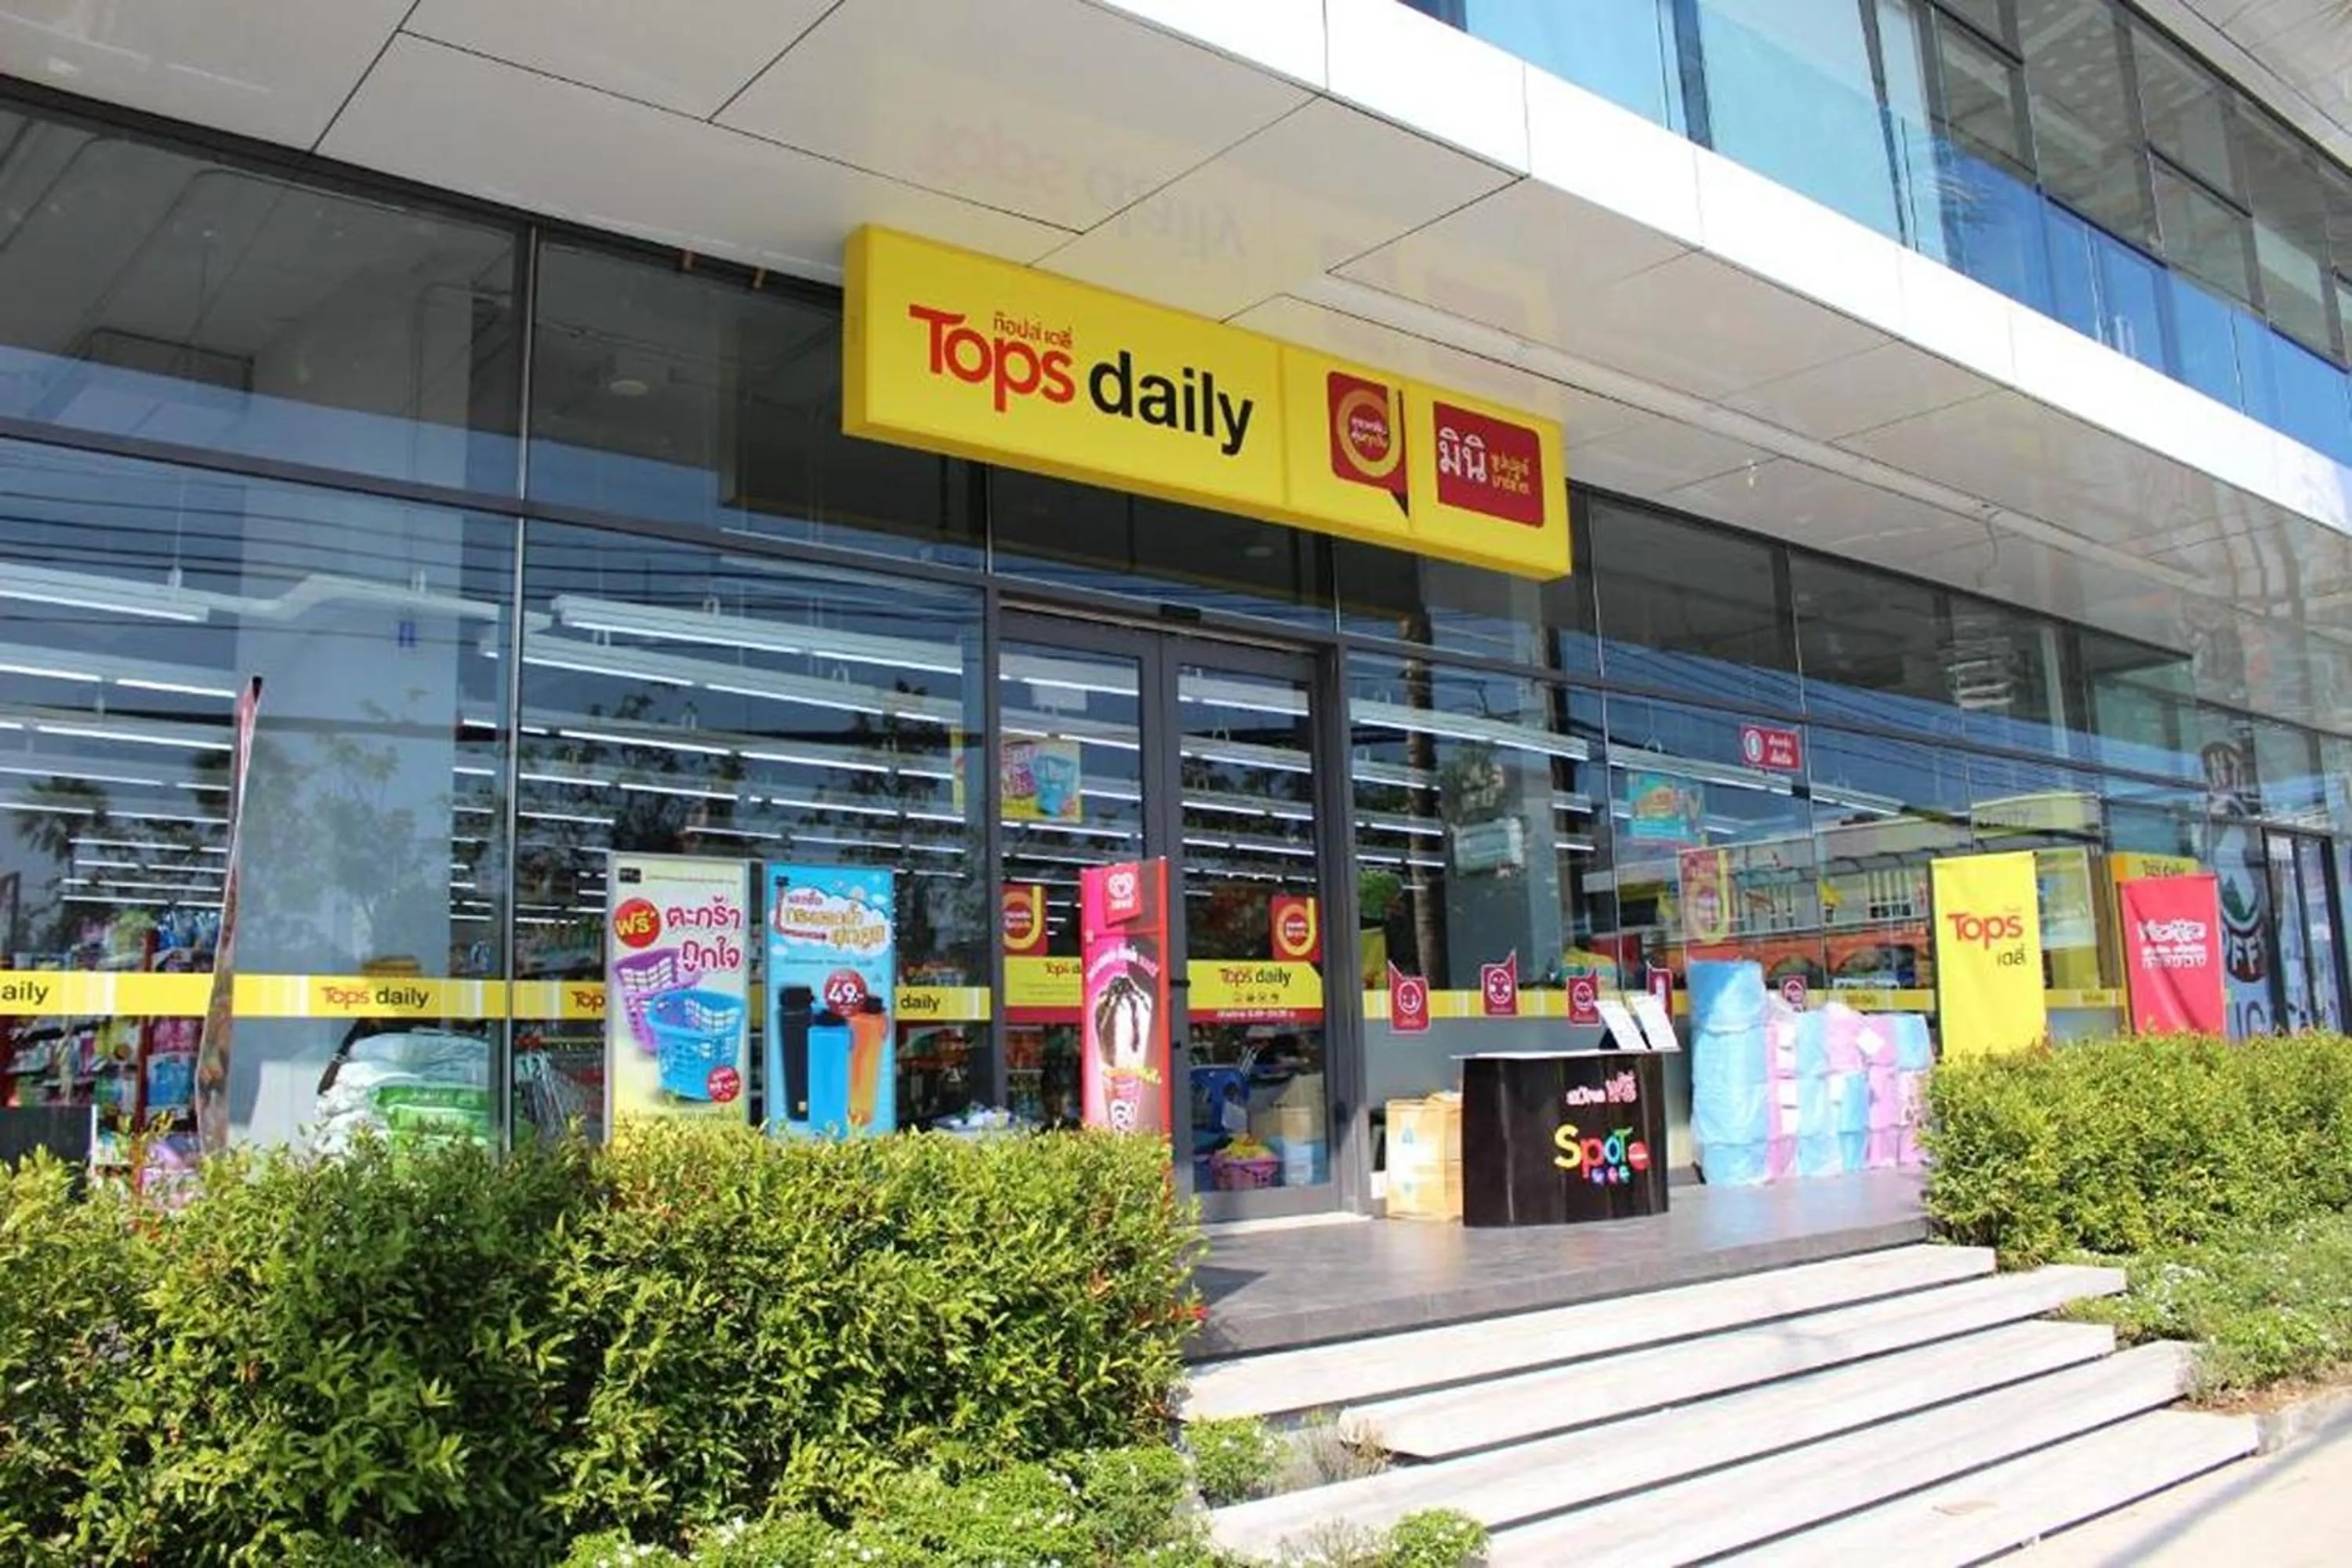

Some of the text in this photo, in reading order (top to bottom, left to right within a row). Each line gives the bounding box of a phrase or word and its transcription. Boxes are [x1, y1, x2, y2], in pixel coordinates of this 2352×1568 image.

[909, 303, 1254, 456] Tops daily
[1439, 426, 1487, 484] มินิ
[667, 896, 741, 929] ตะกร้า
[1947, 913, 2024, 951] Tops
[684, 936, 740, 971] ถูกใจ
[1220, 966, 1292, 987] Tops daily
[2, 981, 50, 1007] aily
[321, 985, 430, 1010] Tops daily
[571, 991, 604, 1013] Top
[899, 993, 940, 1013] daily
